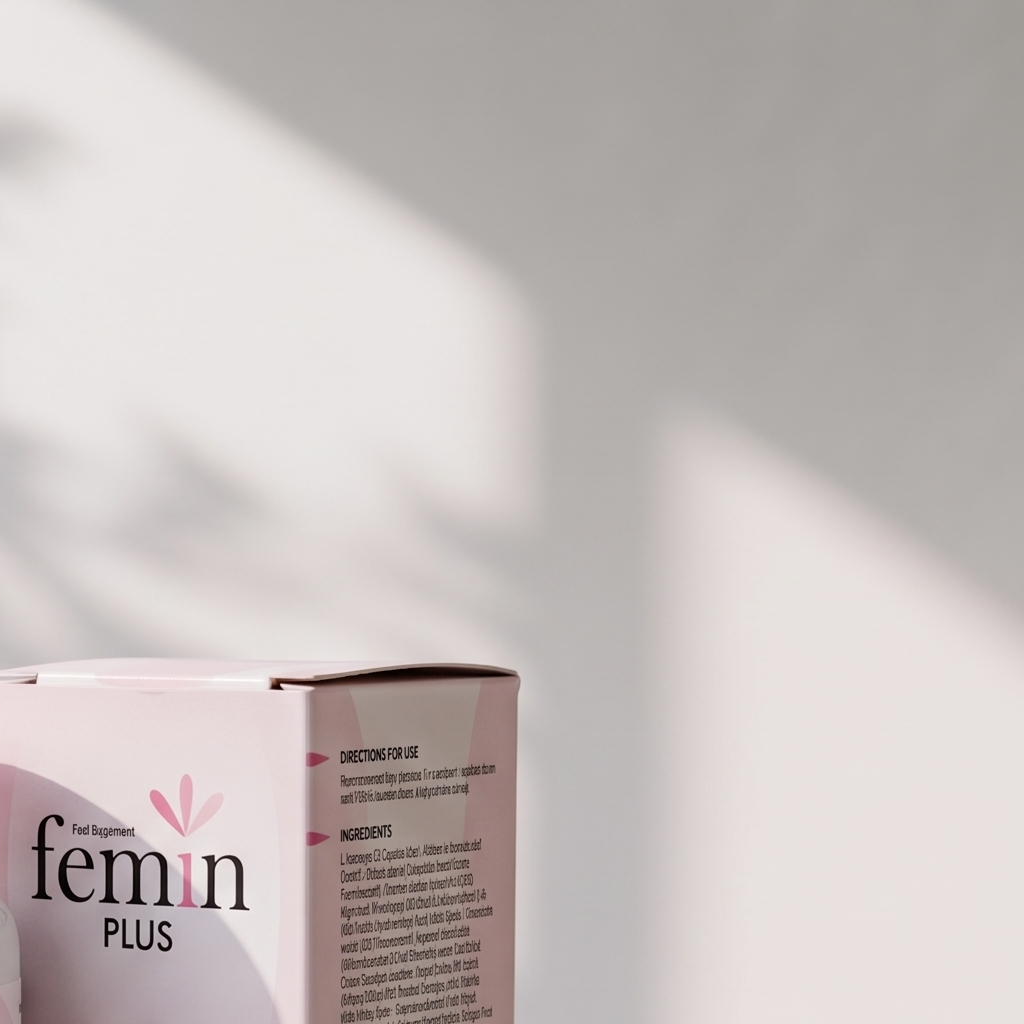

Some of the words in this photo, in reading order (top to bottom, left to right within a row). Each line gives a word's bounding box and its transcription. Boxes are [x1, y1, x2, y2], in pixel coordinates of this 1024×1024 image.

[340, 748, 386, 764] DIRECTIONS
[387, 746, 403, 761] FOR
[404, 745, 419, 760] USE
[340, 824, 392, 842] INGREDIENTS
[31, 814, 250, 911] femin
[104, 917, 173, 952] PLUS
